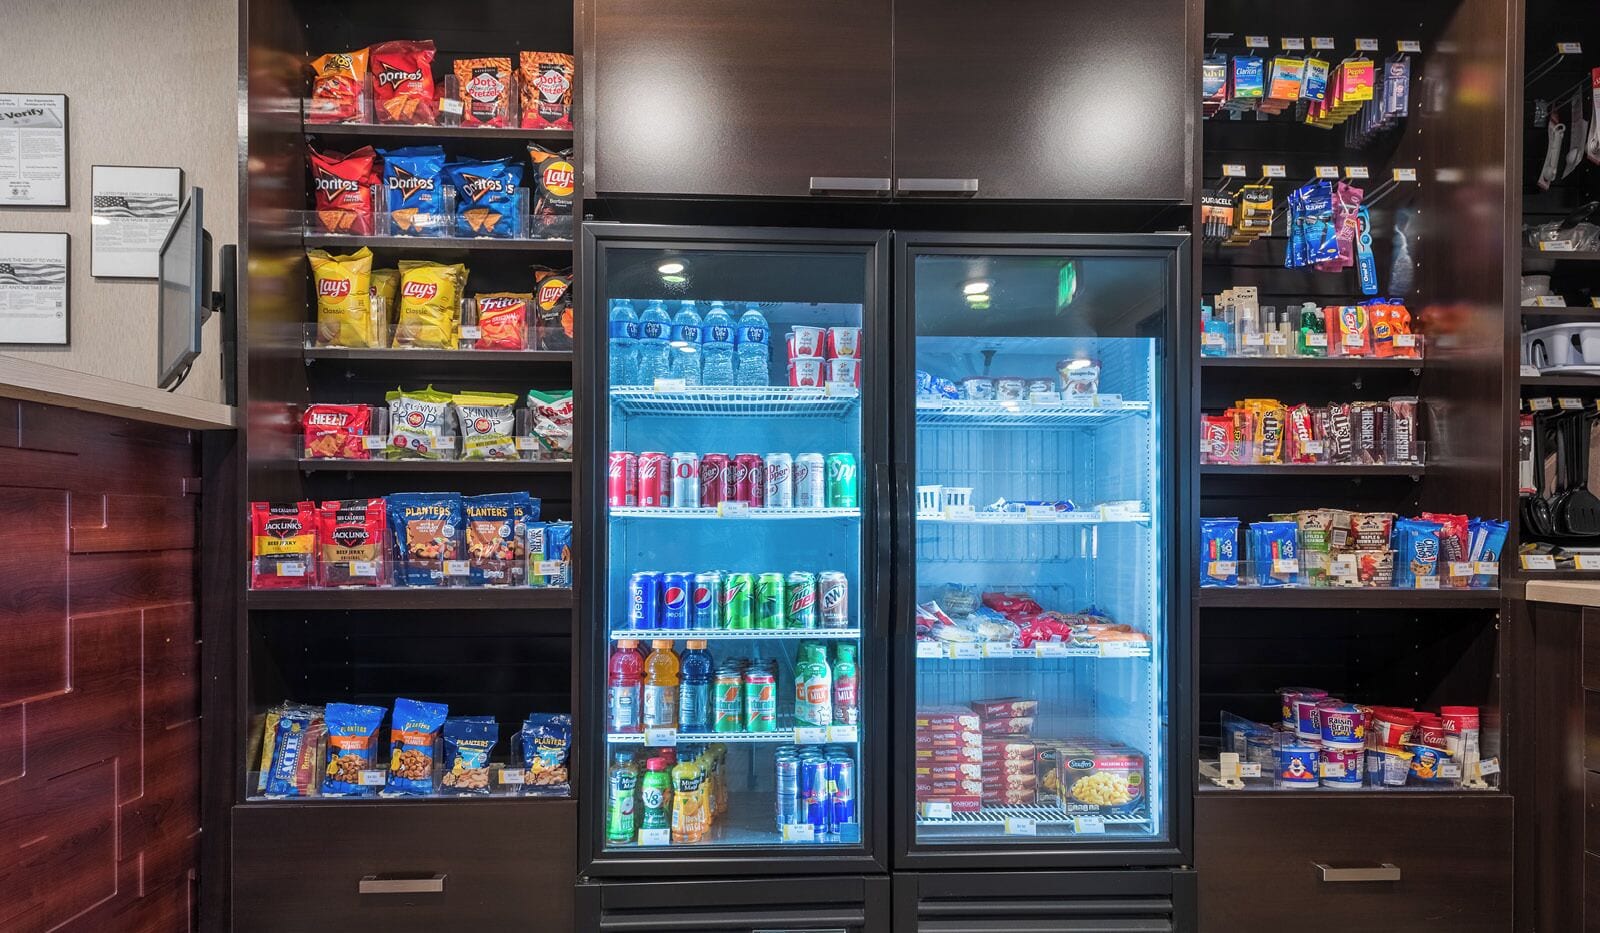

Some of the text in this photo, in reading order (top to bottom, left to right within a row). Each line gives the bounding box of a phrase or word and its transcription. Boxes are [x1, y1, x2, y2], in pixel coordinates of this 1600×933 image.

[1203, 70, 1225, 78] Advil
[1236, 67, 1257, 75] Claritin
[380, 69, 422, 86] Doritos
[473, 78, 497, 87] Dot's
[540, 76, 562, 84] Dot's
[314, 177, 358, 191] Doritos
[389, 177, 434, 190] Doritos
[463, 180, 502, 197] Doritos
[319, 277, 350, 297] Lay's
[403, 281, 437, 299] Lay's
[541, 286, 568, 303] Lay's
[323, 307, 345, 315] Classic
[405, 307, 428, 315] Classic
[463, 406, 500, 417] SKINNY
[465, 417, 501, 436] POP
[1361, 410, 1374, 449] HERSHEY'S
[1396, 418, 1409, 459] HERSHEY'S
[405, 507, 452, 518] PLANTERS
[466, 507, 508, 518] PLANTERS
[280, 522, 303, 530] LINK'S
[349, 531, 369, 539] LINK'S
[634, 586, 644, 619] pepsi
[810, 690, 827, 700] MILK
[838, 690, 854, 700] MILK
[1327, 717, 1352, 726] Raisin
[1330, 723, 1351, 732] Bran
[456, 739, 489, 747] PLANTERS
[534, 738, 567, 747] PLANTERS
[645, 790, 660, 806] V8
